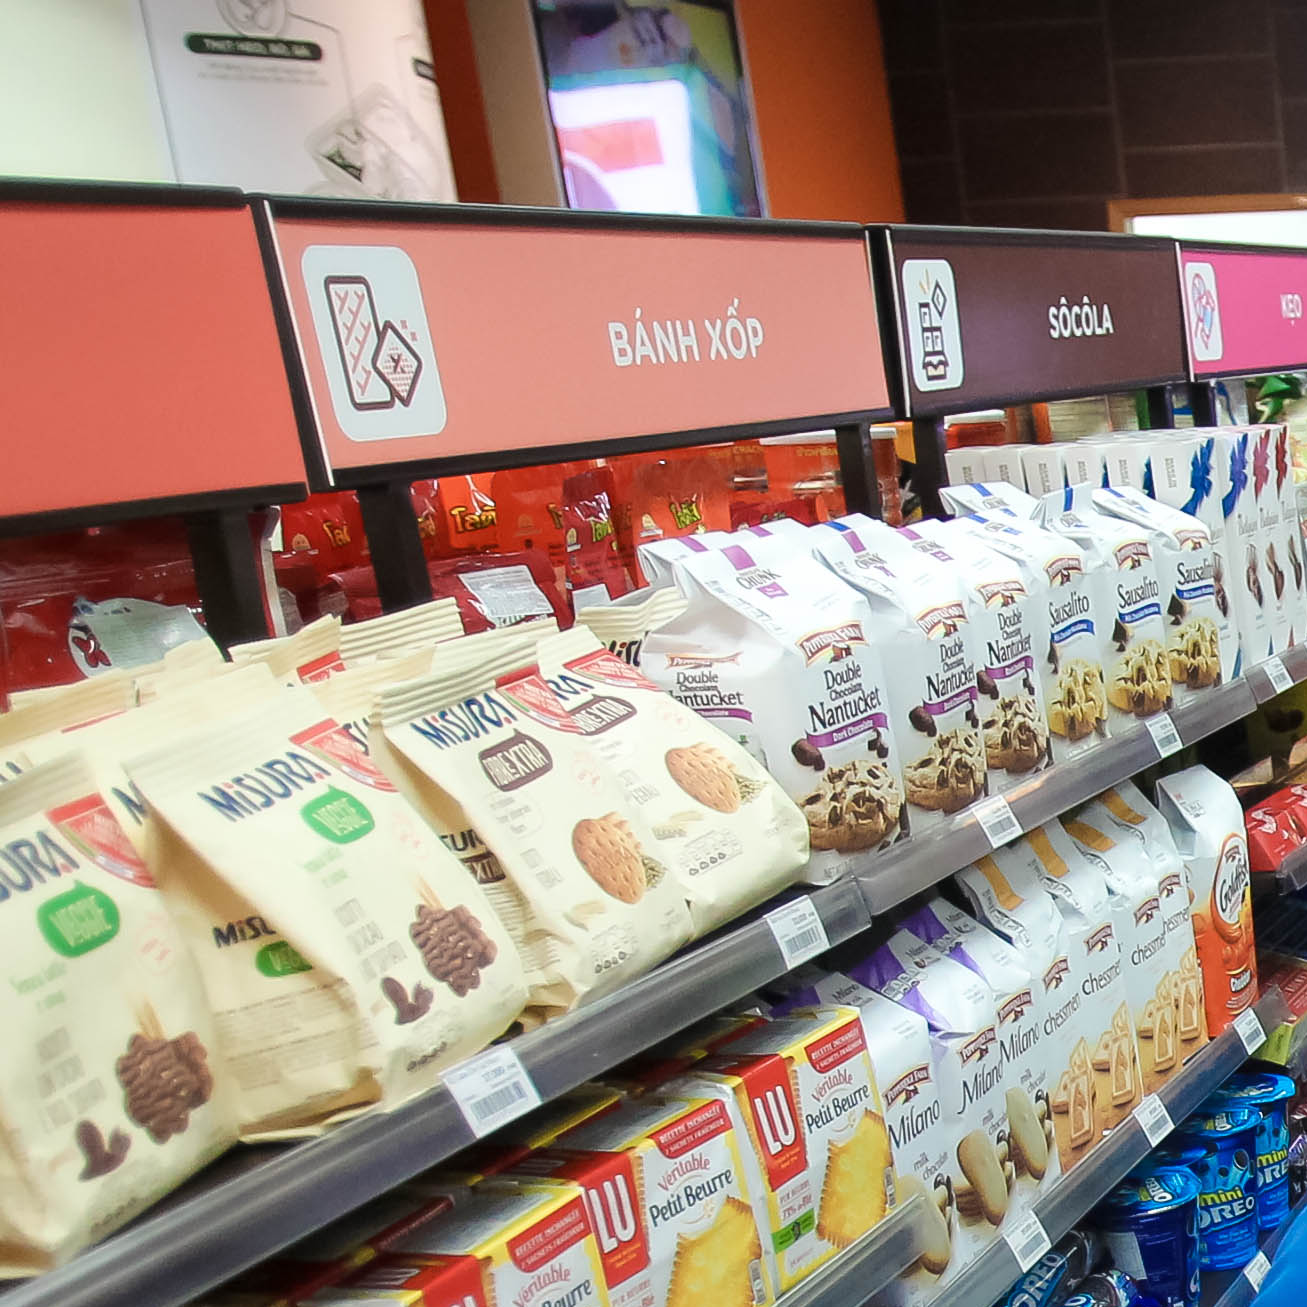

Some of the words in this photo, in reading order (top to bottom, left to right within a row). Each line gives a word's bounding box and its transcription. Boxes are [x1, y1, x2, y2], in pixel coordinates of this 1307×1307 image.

[608, 306, 697, 367] BÁNH
[704, 298, 765, 362] XỐP
[1048, 295, 1114, 339] SÔCÔLA
[1050, 591, 1090, 628] Sausalito
[1117, 576, 1159, 610] Sausalito
[987, 632, 1032, 667] Nantucket
[676, 671, 719, 685] Double
[824, 661, 863, 691] Double
[926, 661, 976, 701] Nantucket
[808, 687, 882, 733] Nantucket
[1000, 1021, 1040, 1065] Milano
[753, 1085, 796, 1156] LU
[805, 1106, 834, 1134] Petit
[832, 1084, 870, 1116] Beurre
[887, 1098, 941, 1150] Milano
[588, 1174, 636, 1254] LU
[649, 1192, 686, 1228] Petit
[684, 1167, 733, 1208] Beurre
